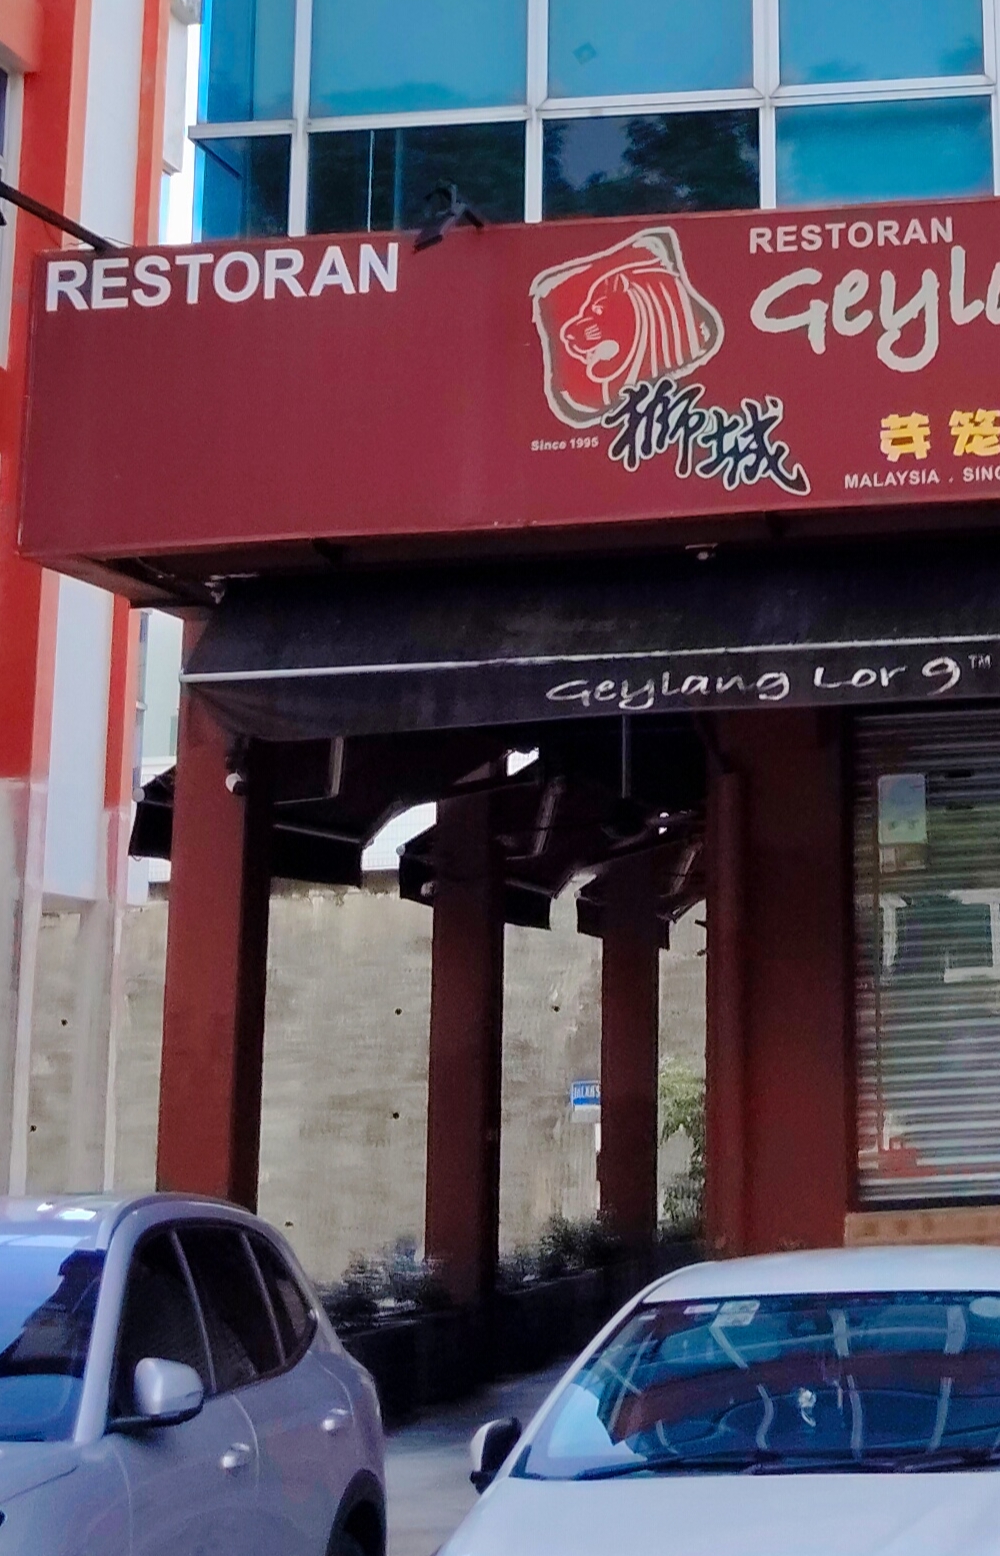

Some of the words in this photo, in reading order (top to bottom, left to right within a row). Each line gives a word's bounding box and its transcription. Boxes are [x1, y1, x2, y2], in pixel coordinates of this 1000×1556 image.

[748, 217, 955, 254] RESTORAN
[46, 243, 400, 312] RESTORAN
[531, 439, 566, 451] Since
[569, 436, 599, 449] 1995
[844, 469, 940, 489] MALAYSIA
[546, 670, 790, 710] Geylang
[814, 664, 906, 688] Lor
[921, 656, 962, 696] 9
